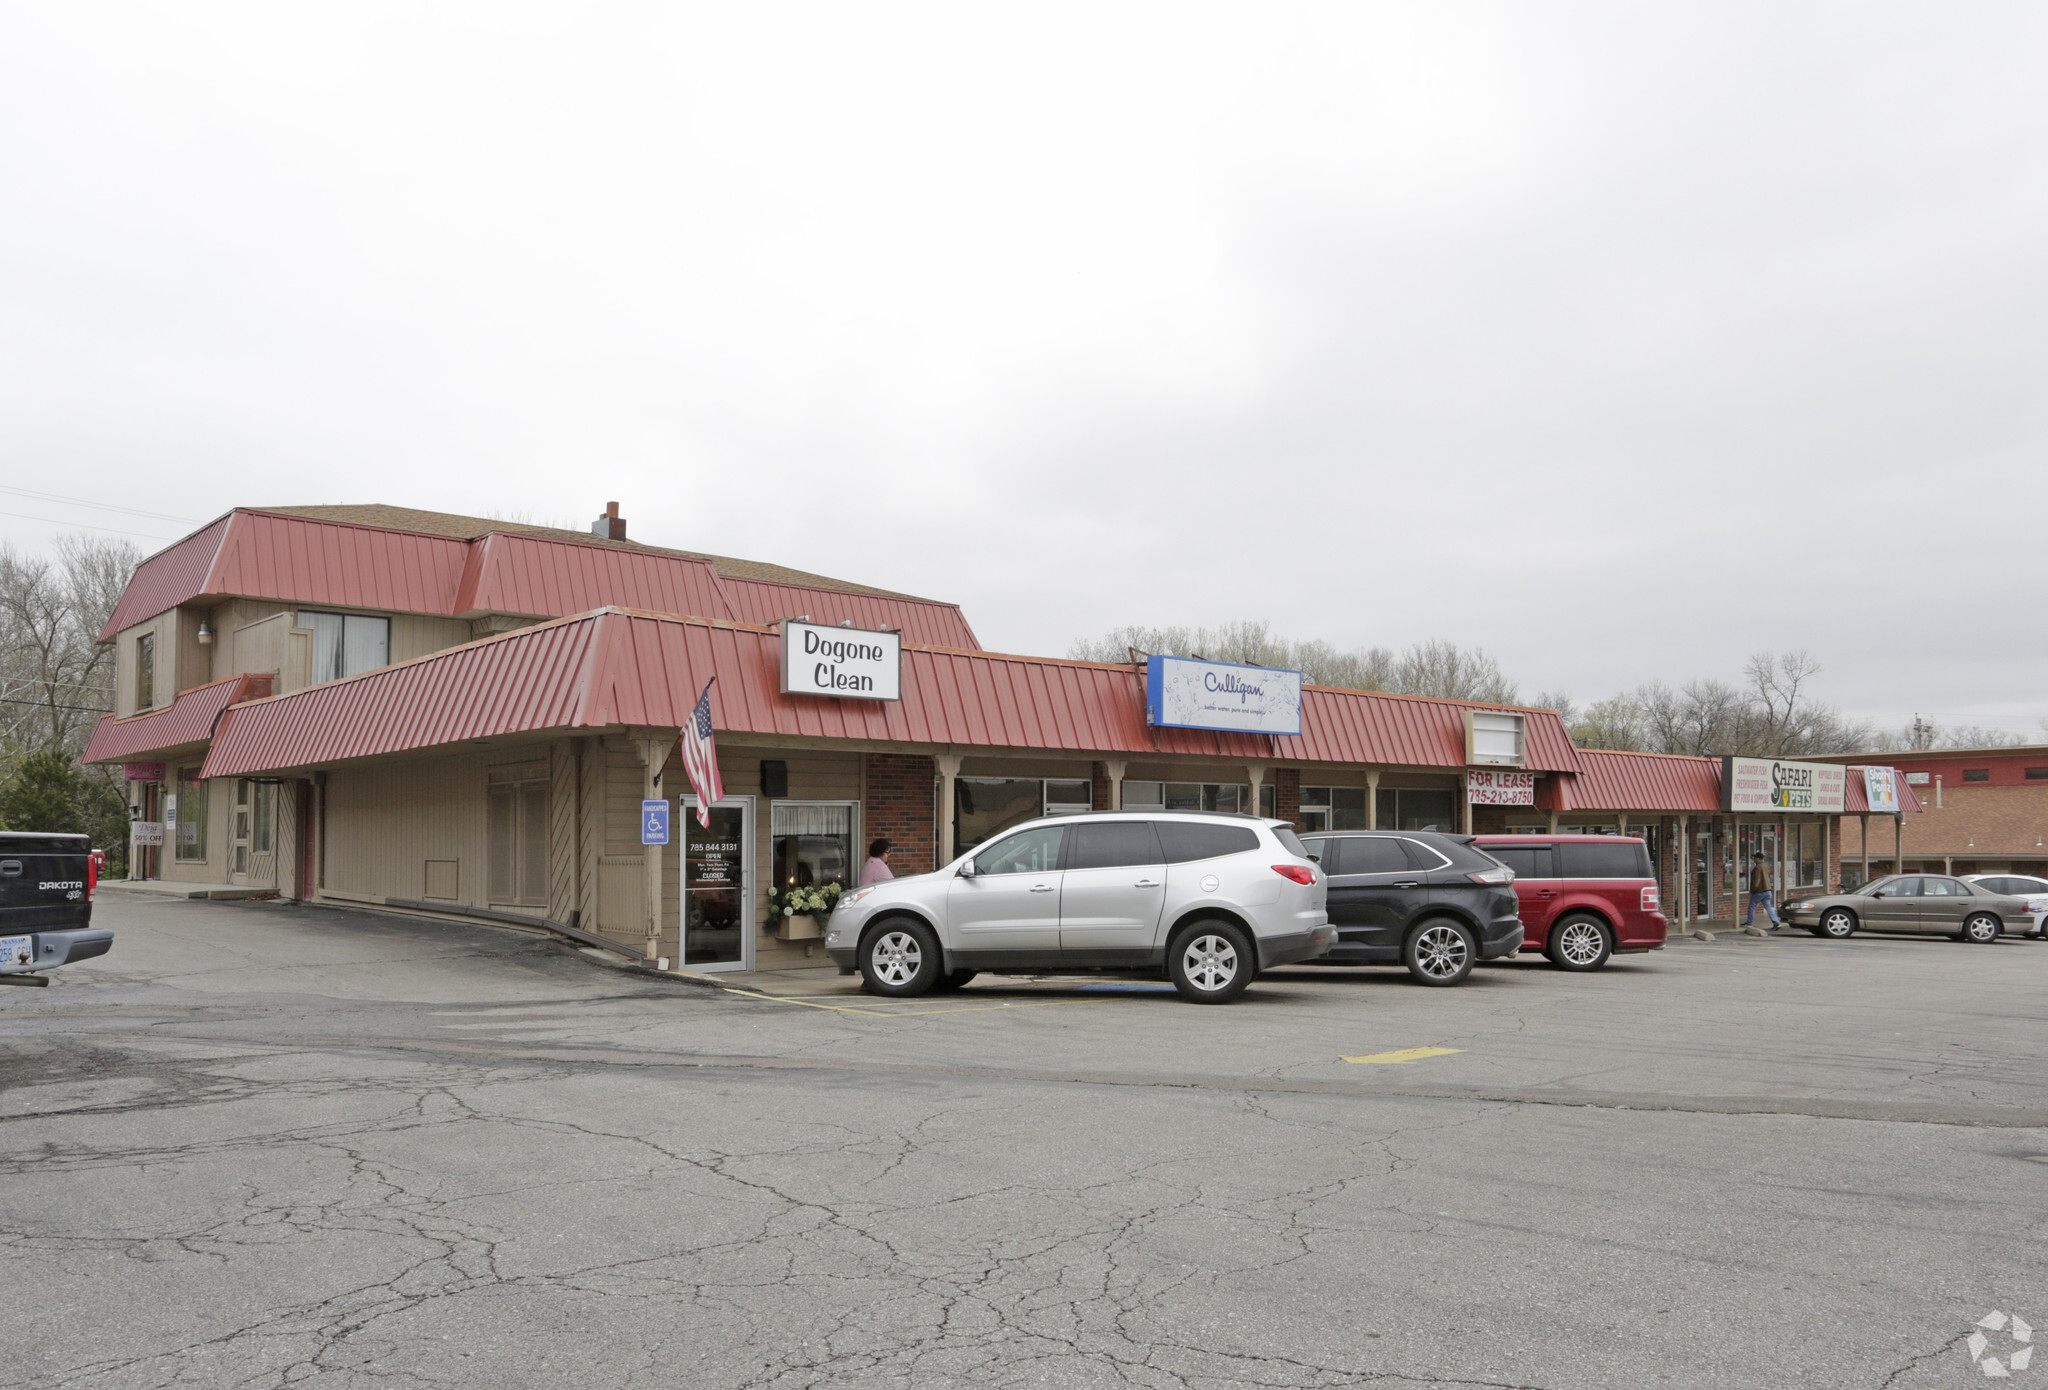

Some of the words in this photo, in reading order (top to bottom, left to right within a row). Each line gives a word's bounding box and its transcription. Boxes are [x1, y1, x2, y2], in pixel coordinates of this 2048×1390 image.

[804, 630, 883, 663] Dogone
[814, 663, 873, 691] Clean
[1204, 672, 1264, 704] Culligan
[1469, 771, 1493, 787] FOR
[1496, 773, 1533, 788] LEASE
[1771, 762, 1812, 804] SAFARI
[1469, 789, 1533, 804] 785-213-8750
[1789, 789, 1812, 808] PETS
[690, 843, 704, 851] 785
[705, 843, 720, 851] 844
[721, 843, 737, 851] 3131
[39, 881, 83, 890] DAKOTA
